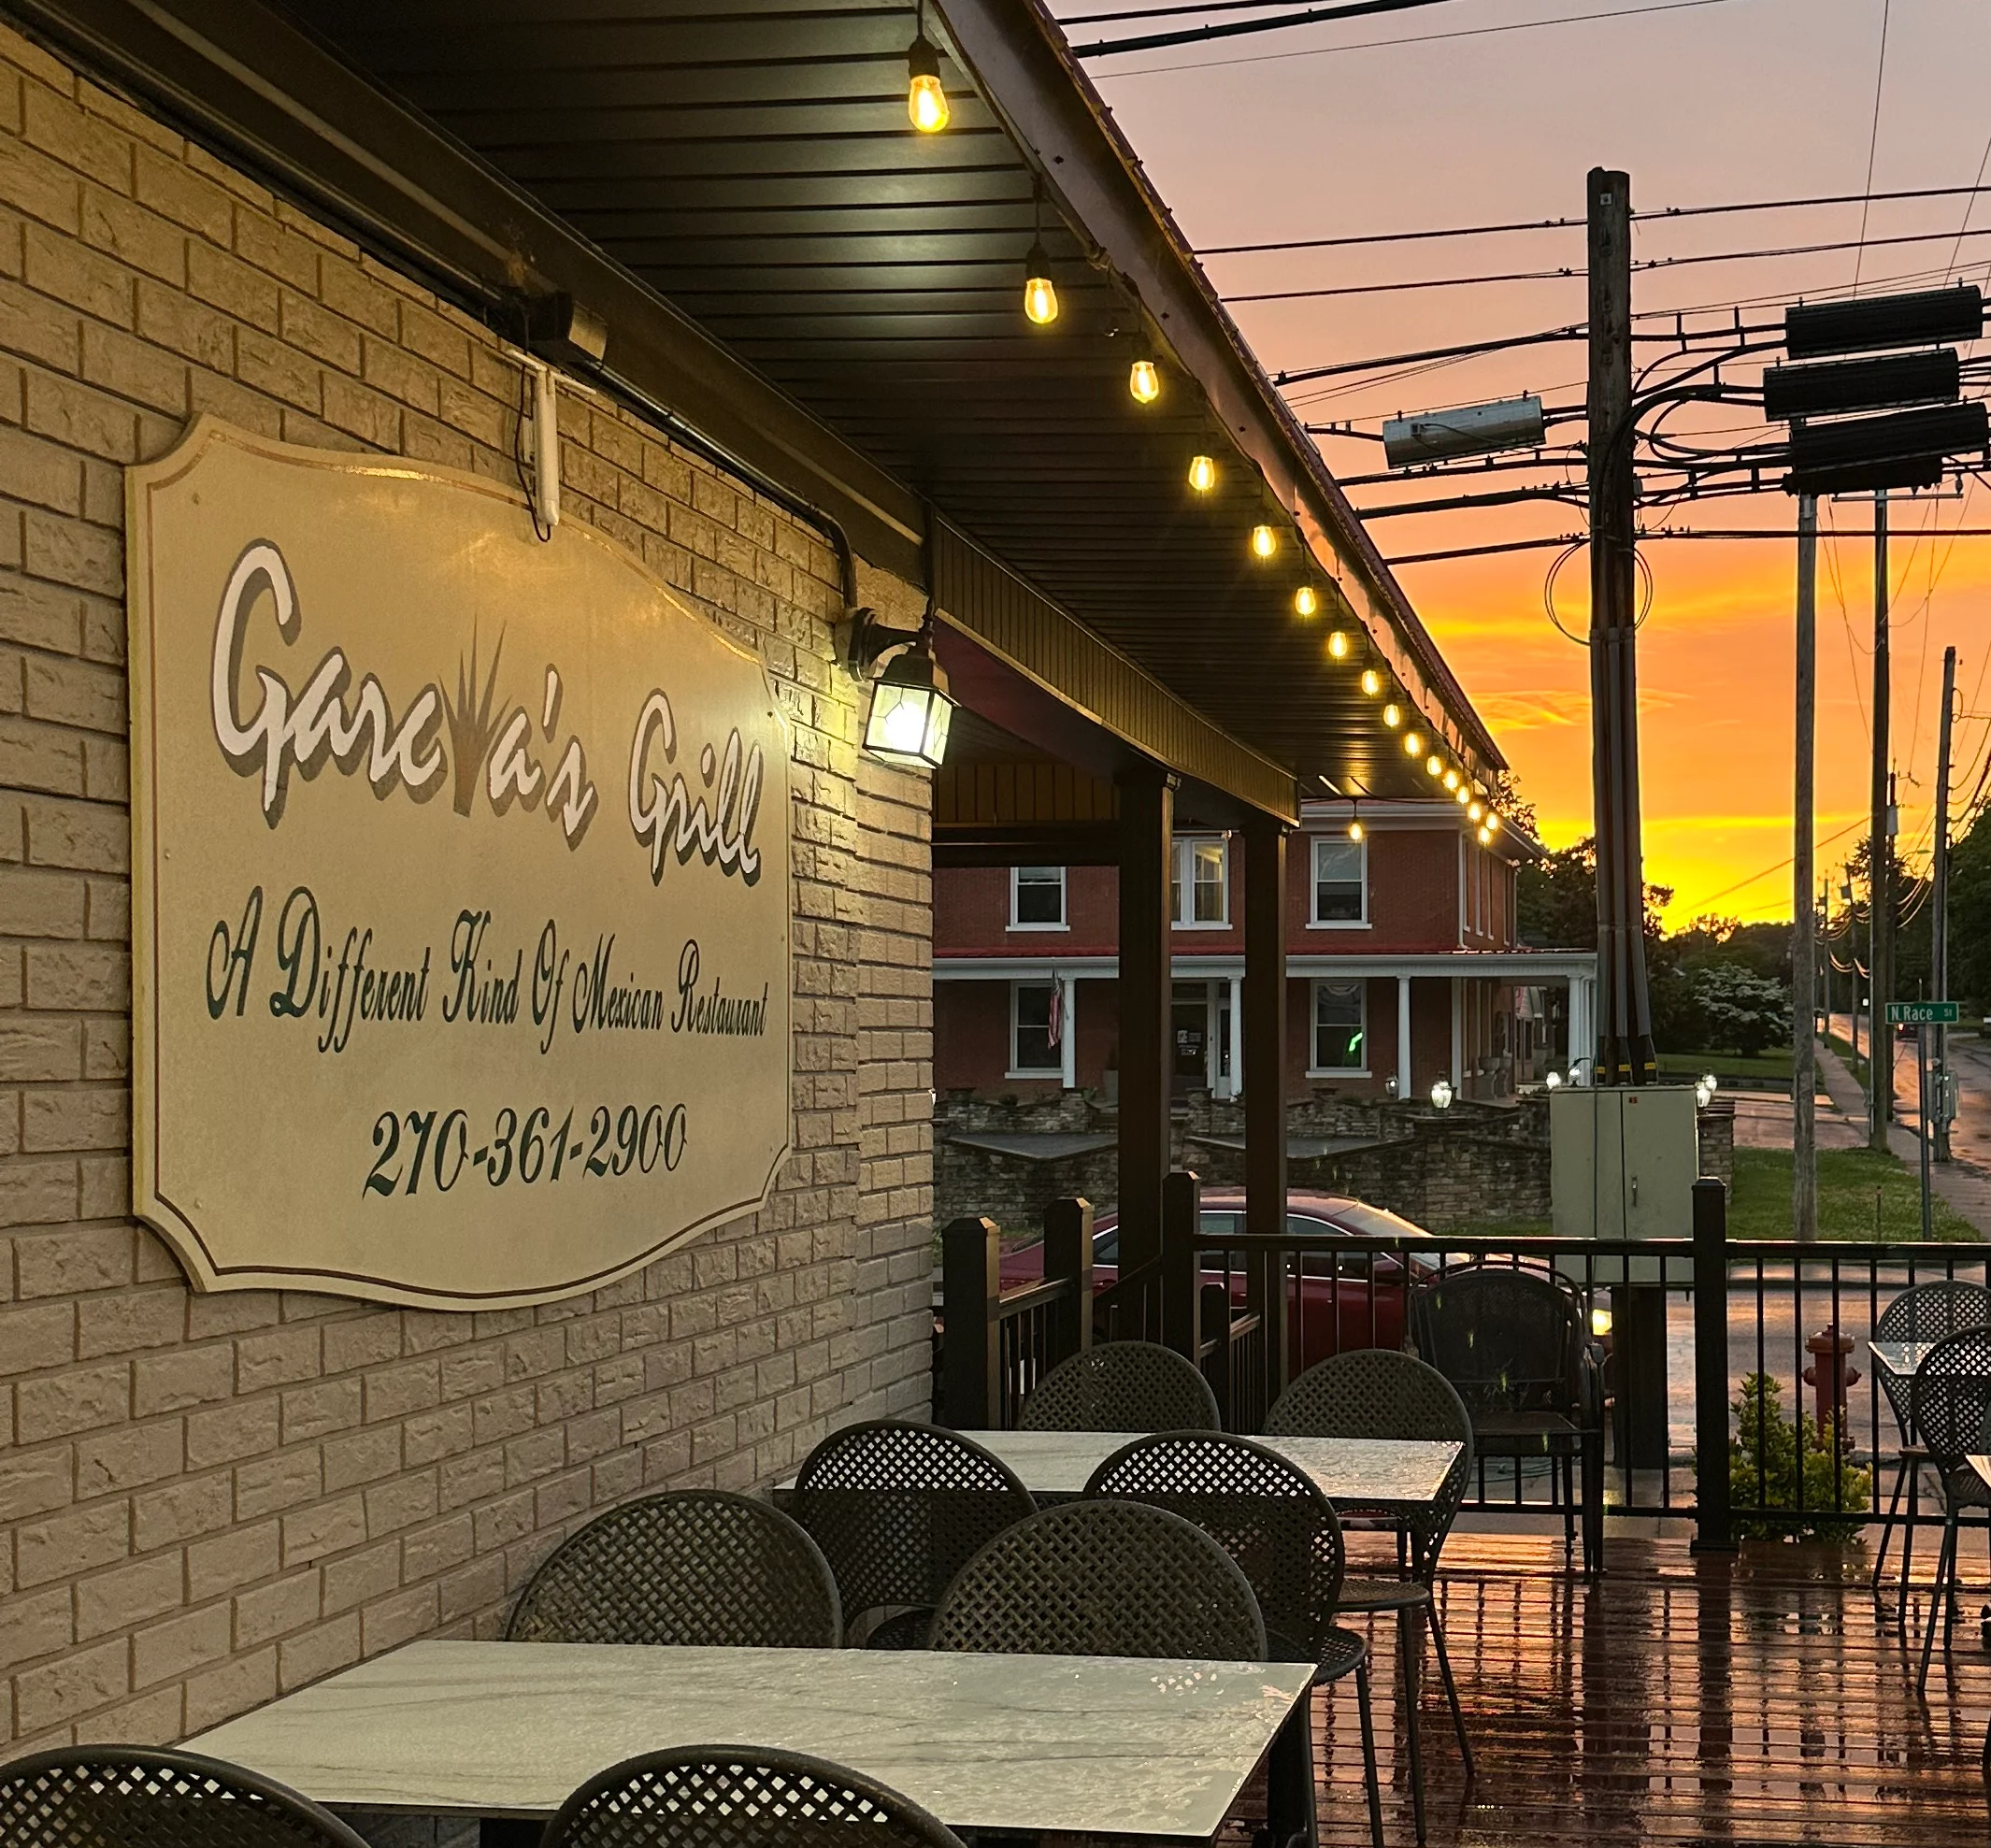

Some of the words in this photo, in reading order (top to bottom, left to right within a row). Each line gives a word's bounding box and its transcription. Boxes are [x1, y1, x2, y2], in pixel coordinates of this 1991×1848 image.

[629, 687, 764, 887] Grill
[207, 885, 263, 1020] A
[269, 886, 432, 1053] Different
[442, 909, 523, 1024] Kind
[532, 919, 570, 1055] Of
[572, 933, 665, 1033] Mexican
[670, 938, 769, 1037] Restaurant
[1903, 1006, 1934, 1021] Race
[362, 1103, 688, 1200] 270-361-2900
